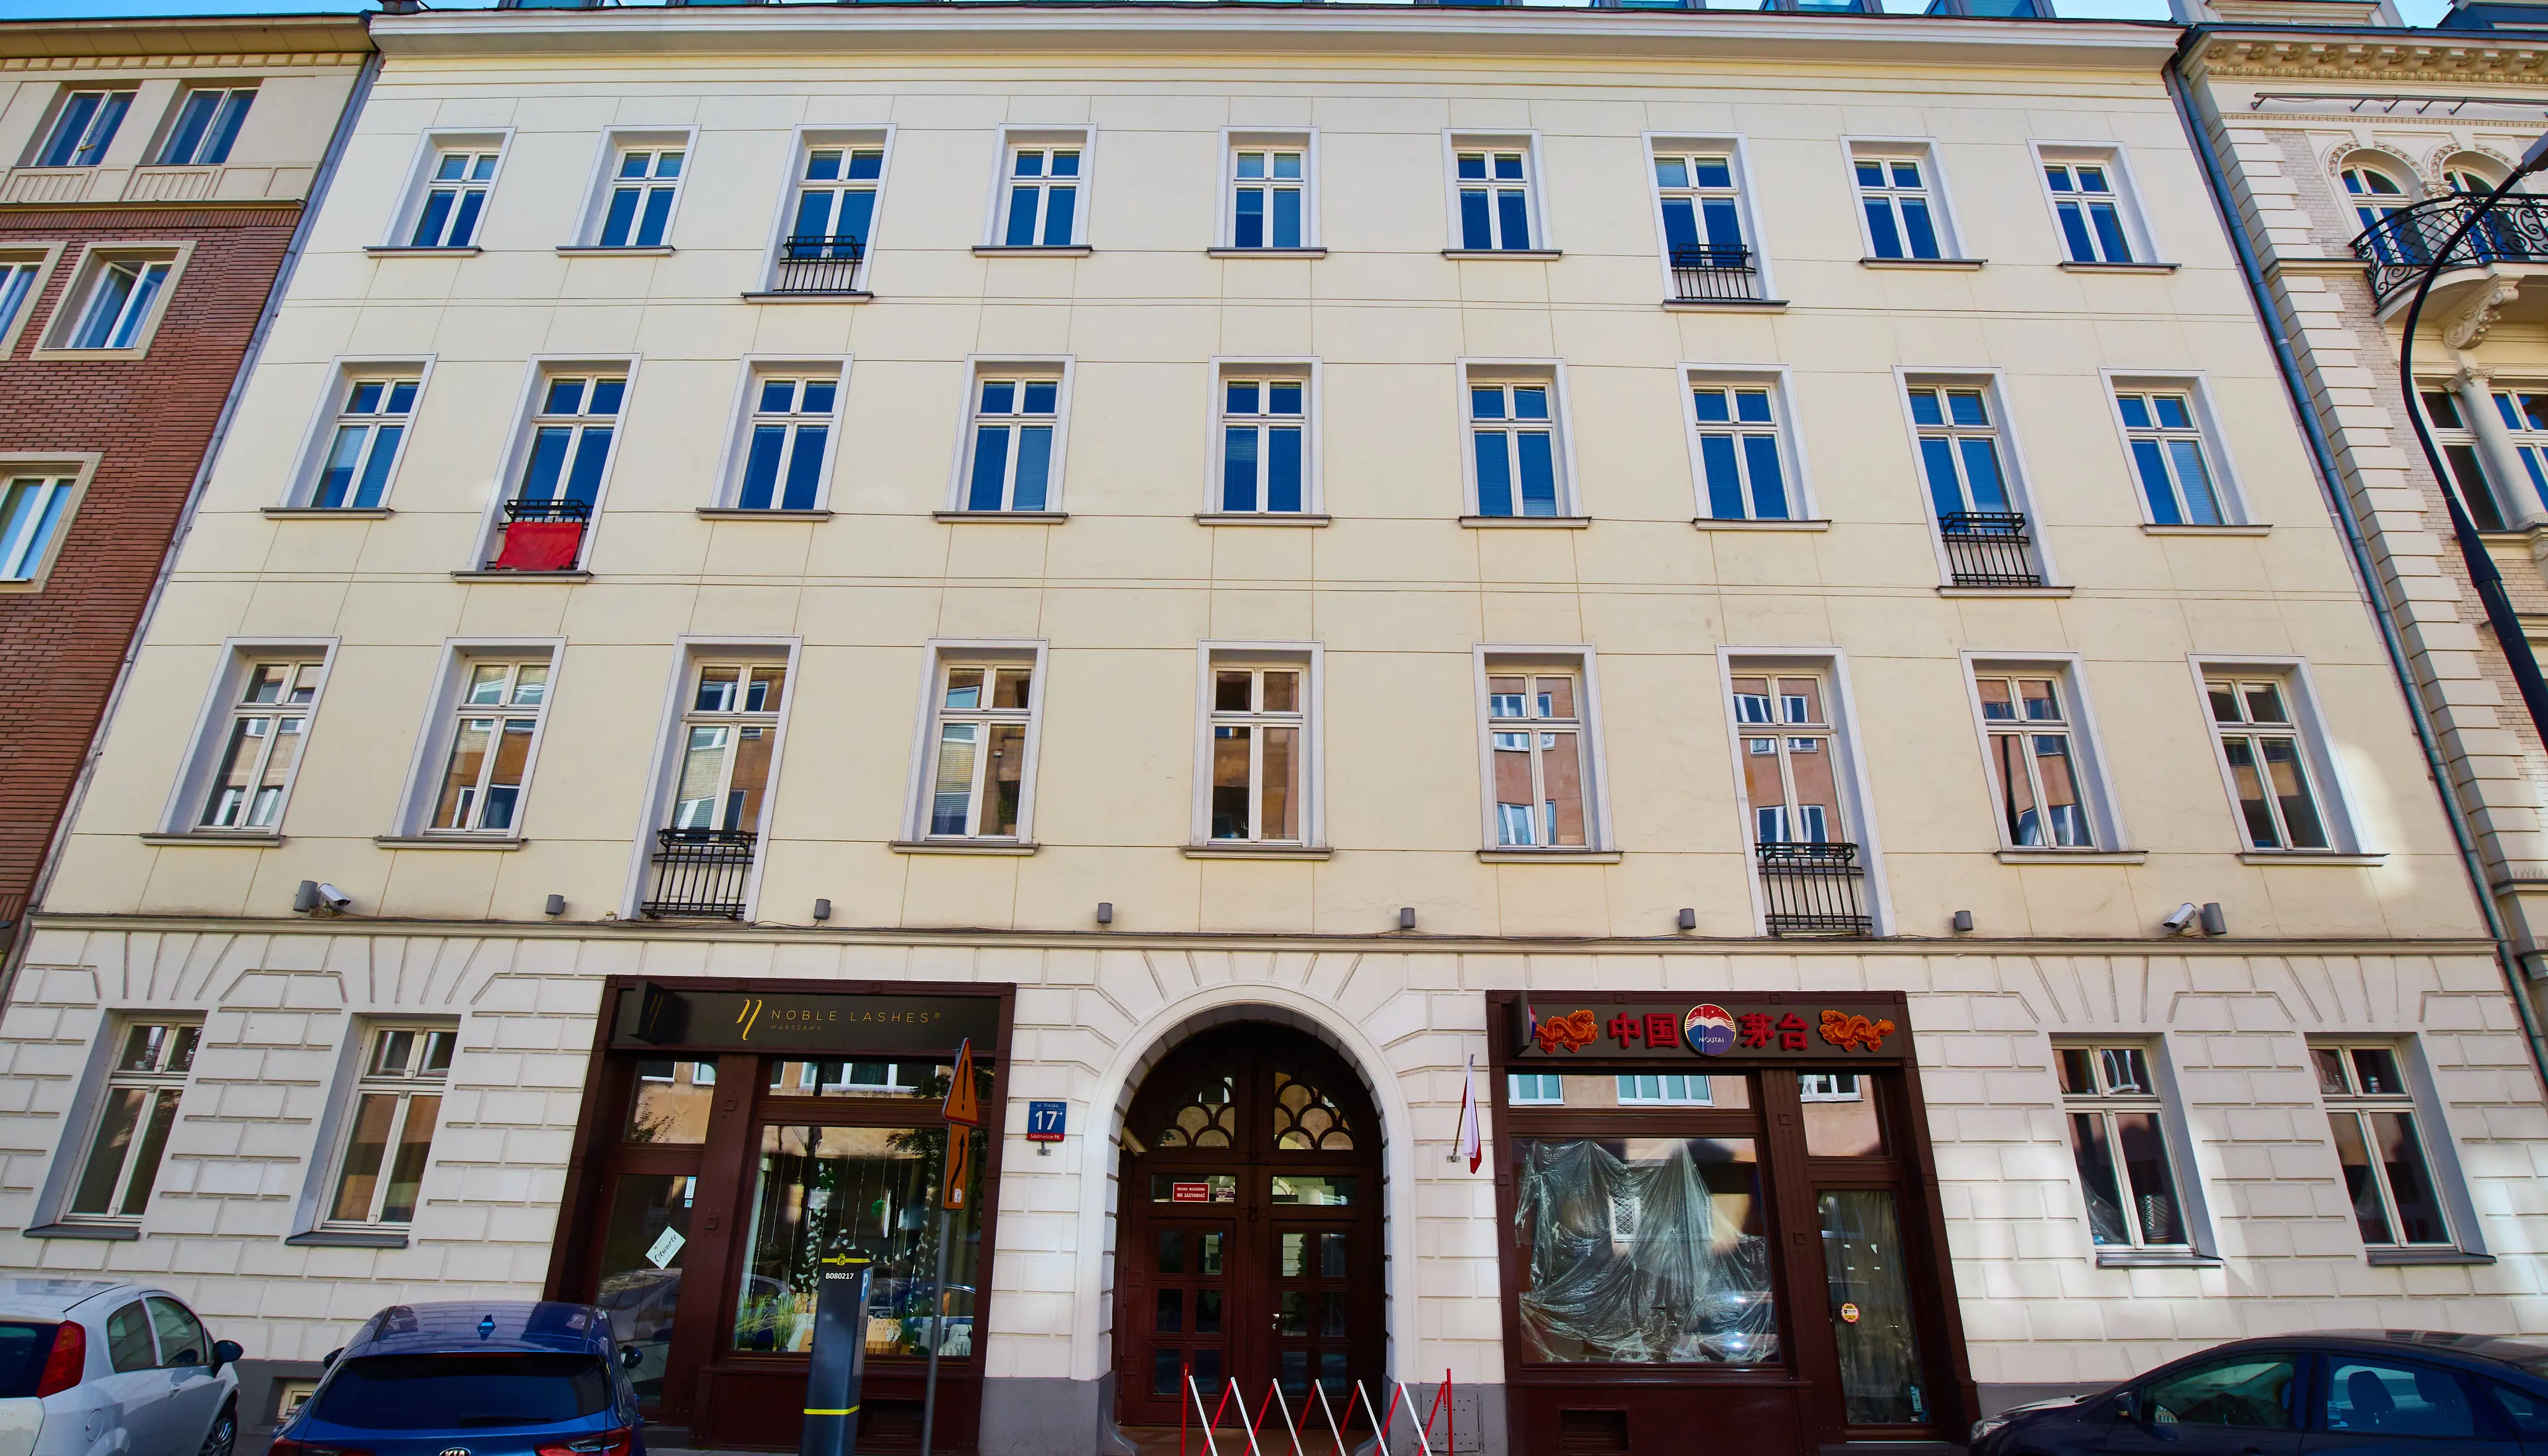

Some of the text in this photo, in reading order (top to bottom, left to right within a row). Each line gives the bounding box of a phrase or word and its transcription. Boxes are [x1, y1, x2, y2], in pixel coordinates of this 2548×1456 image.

[772, 1010, 837, 1021] NOBLE
[1608, 1012, 1809, 1050] 中国 茅台
[1035, 1110, 1058, 1130] 17
[861, 1273, 869, 1297] P
